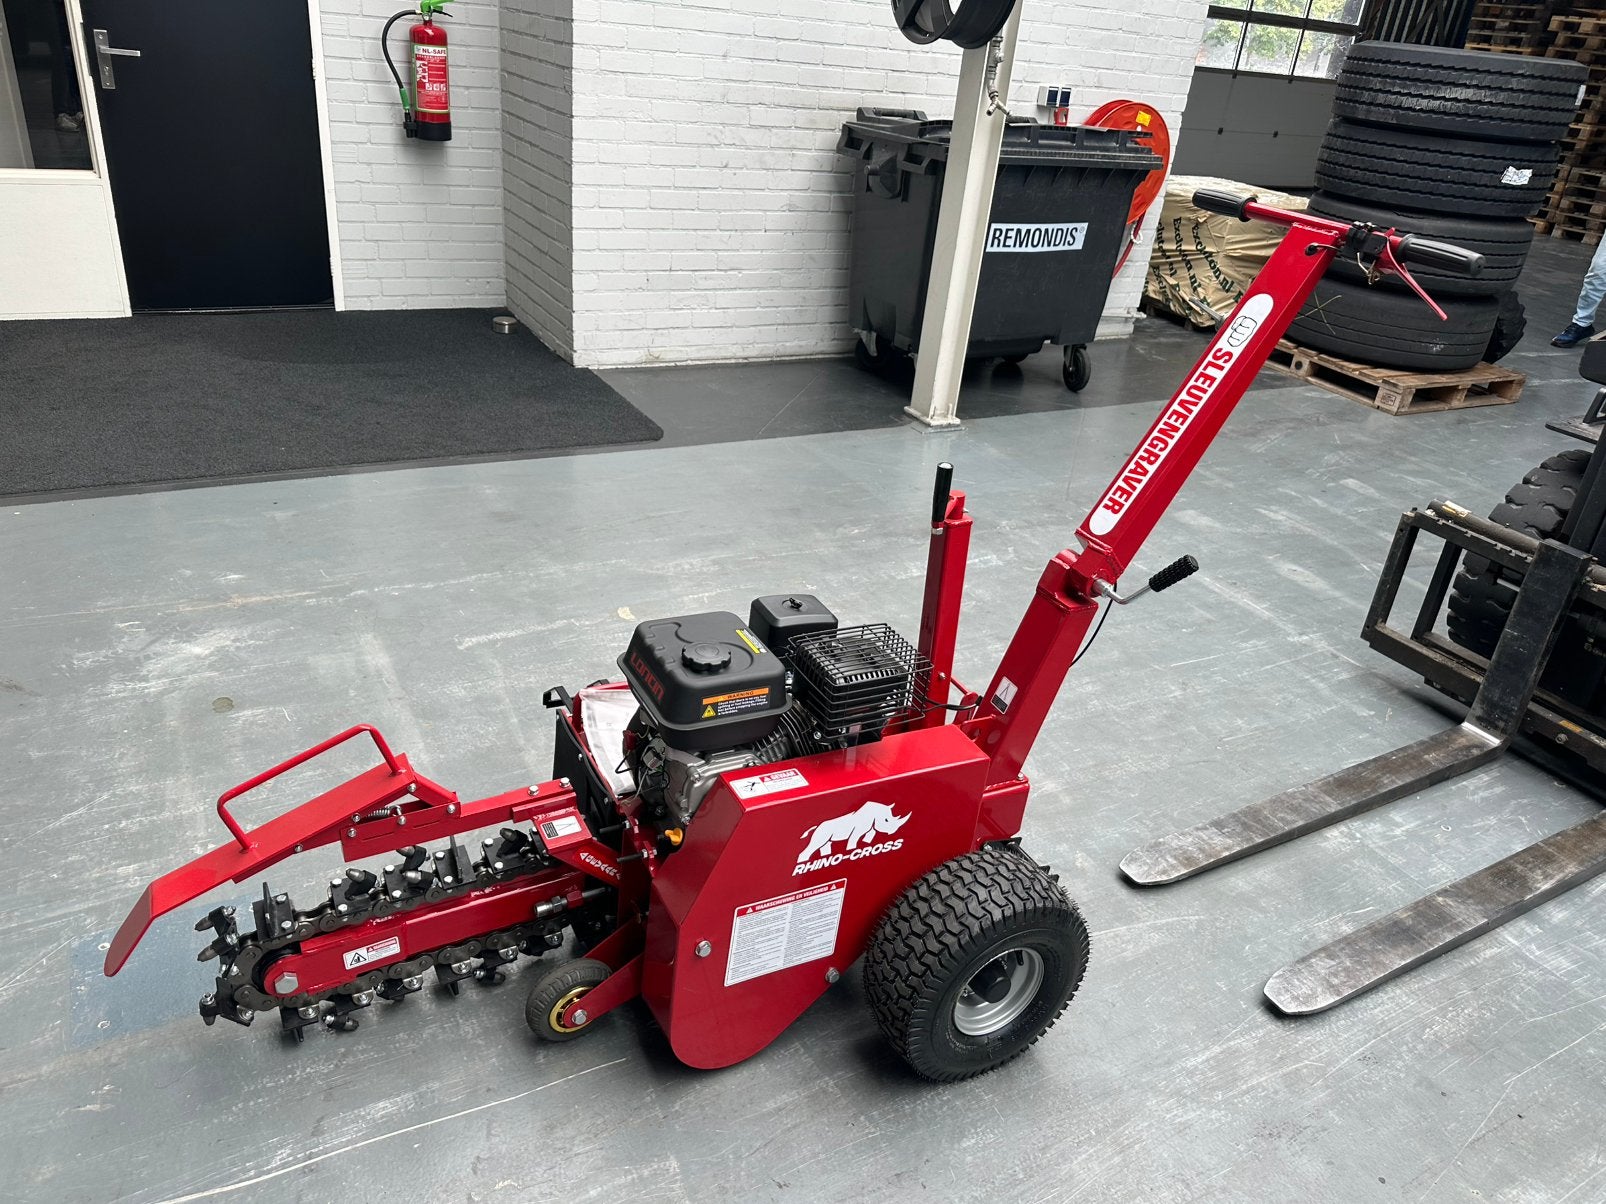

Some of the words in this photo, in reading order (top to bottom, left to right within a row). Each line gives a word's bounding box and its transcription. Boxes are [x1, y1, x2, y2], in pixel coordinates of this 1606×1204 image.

[990, 227, 1078, 248] REMONDIS
[1102, 347, 1234, 515] SLEUVENGRAVER
[727, 690, 754, 699] WARNING
[792, 839, 904, 876] RHINO-CROSS
